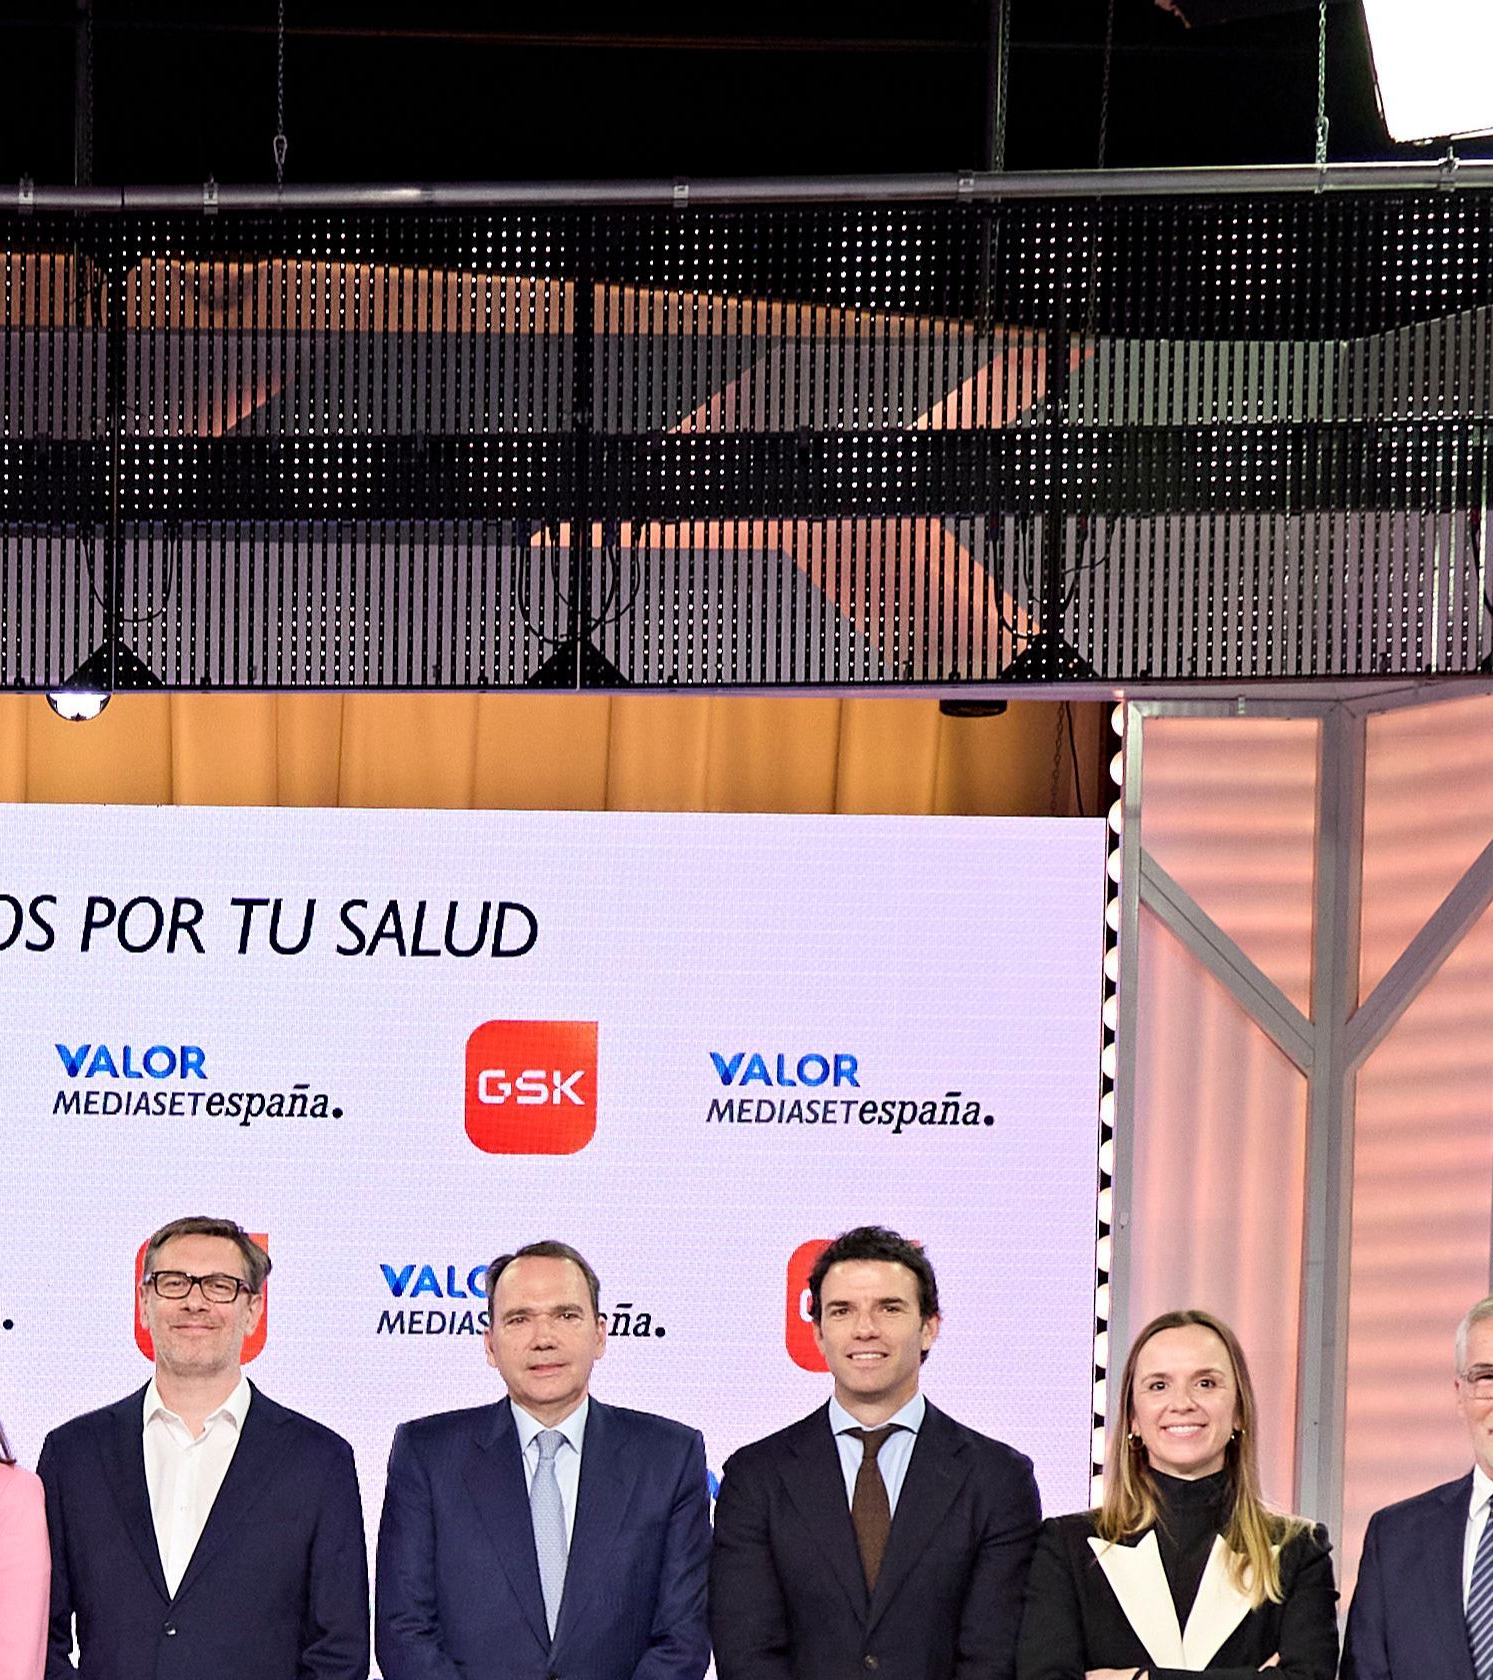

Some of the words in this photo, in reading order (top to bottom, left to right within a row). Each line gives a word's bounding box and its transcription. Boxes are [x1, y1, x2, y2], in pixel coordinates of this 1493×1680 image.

[80, 895, 206, 954] POR
[230, 897, 317, 956] TU
[336, 898, 539, 958] SALUD
[54, 1043, 208, 1080] VALOR
[709, 1051, 861, 1088] VALOR
[478, 1069, 585, 1106] GSK
[379, 1263, 488, 1299] VALO
